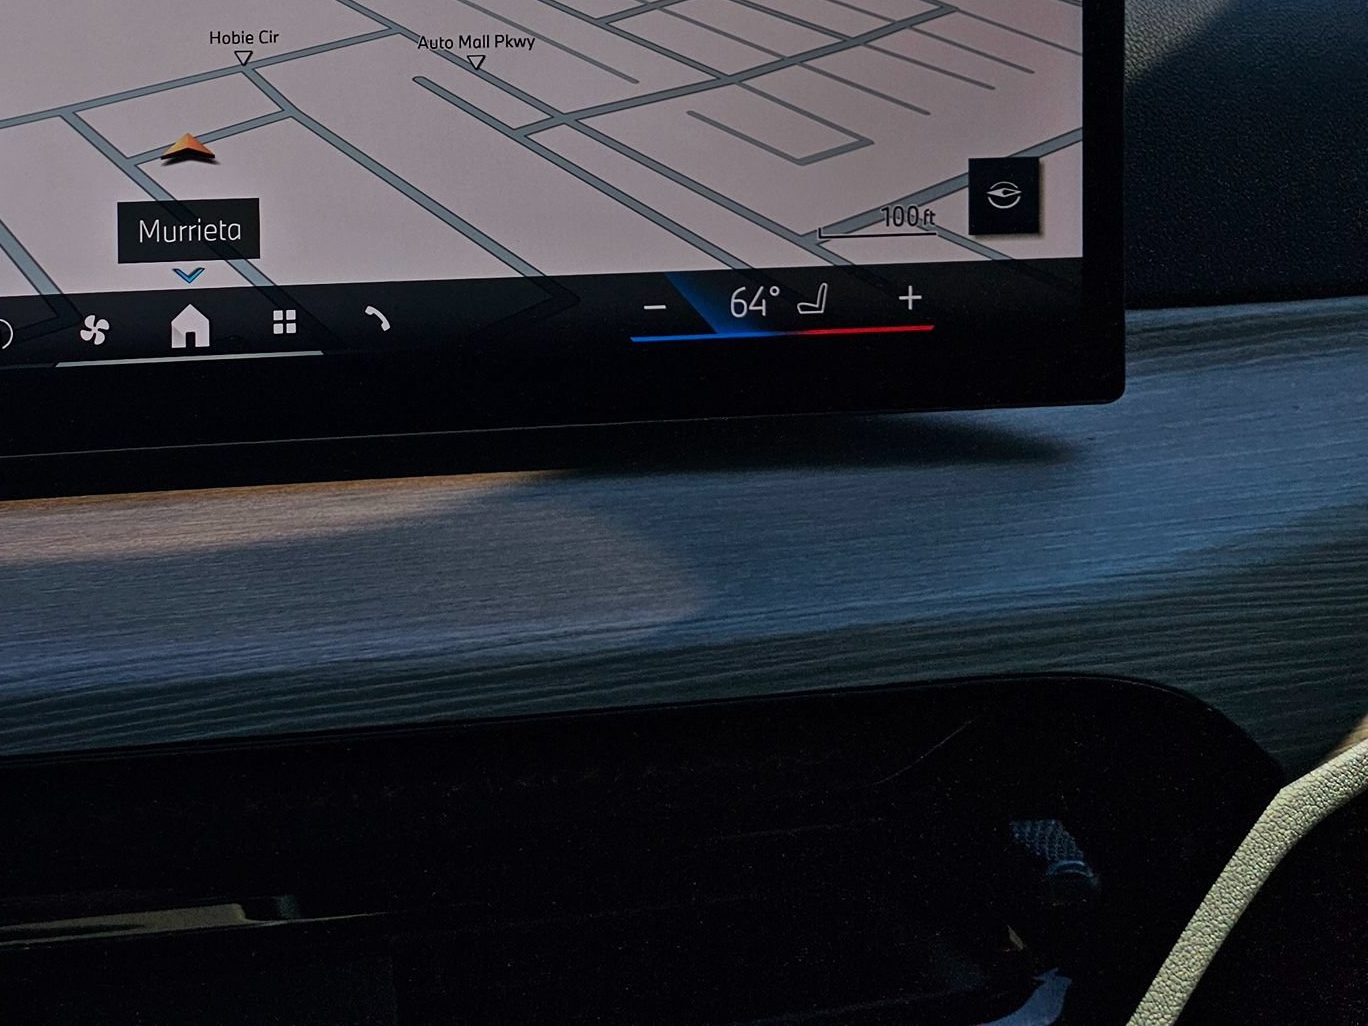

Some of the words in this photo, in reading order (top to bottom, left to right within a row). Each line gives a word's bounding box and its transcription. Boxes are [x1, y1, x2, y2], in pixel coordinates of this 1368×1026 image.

[209, 30, 254, 45] Hobie
[258, 29, 280, 45] Cir
[417, 35, 454, 50] Auto
[458, 34, 490, 49] Mall
[494, 34, 536, 51] Pkwy
[881, 205, 920, 227] 100
[923, 208, 936, 225] ft
[139, 217, 241, 244] Murrieta
